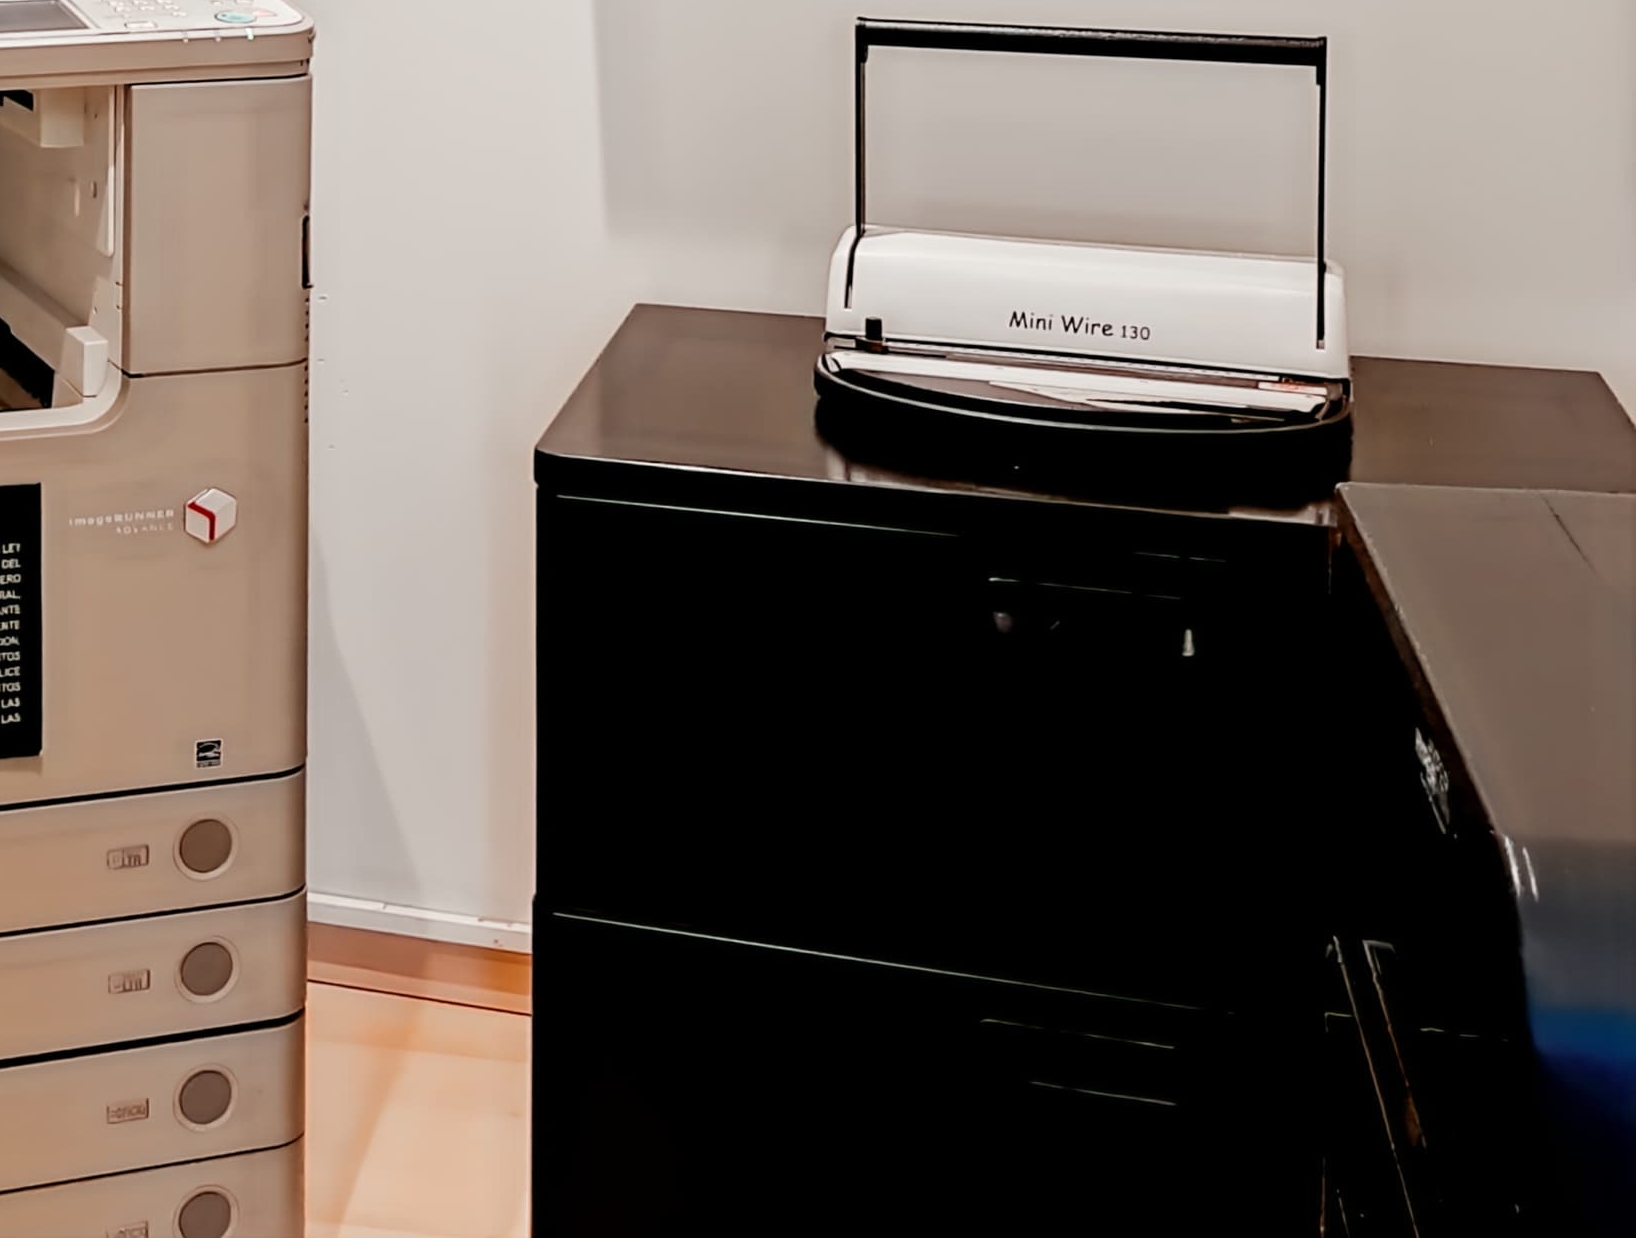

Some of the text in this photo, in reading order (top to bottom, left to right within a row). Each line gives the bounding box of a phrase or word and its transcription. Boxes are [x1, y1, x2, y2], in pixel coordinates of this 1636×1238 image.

[1008, 310, 1152, 341] Mini Wire 130
